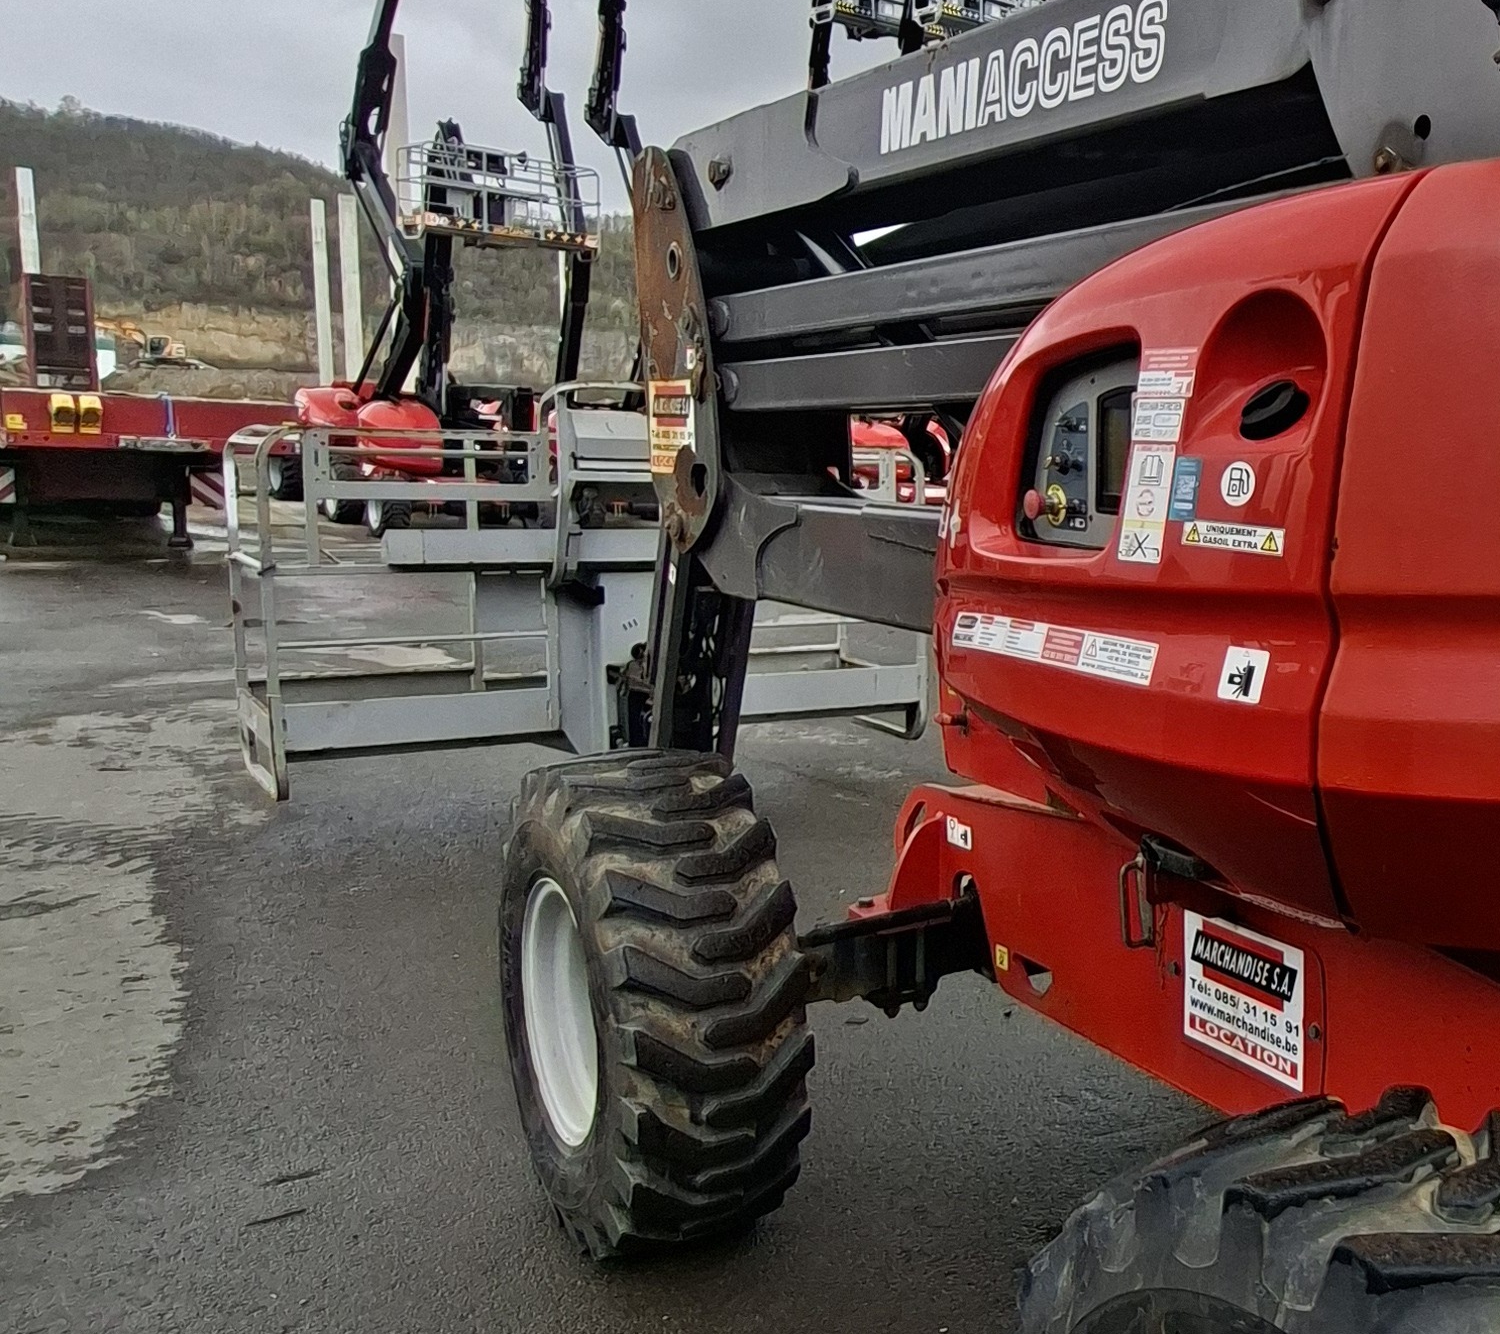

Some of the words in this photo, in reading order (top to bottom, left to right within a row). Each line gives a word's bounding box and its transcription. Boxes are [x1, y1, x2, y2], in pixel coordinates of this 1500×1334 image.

[1202, 536, 1229, 546] GASOIL
[1232, 539, 1258, 550] EXTRA
[1206, 525, 1257, 537] UNIQUEMENT
[1194, 935, 1270, 986] MARCHANDISE
[1271, 968, 1291, 997] S.A.
[1189, 977, 1211, 997] Tél:
[1243, 1001, 1257, 1017] 31
[1262, 1010, 1277, 1026] 15
[1285, 1020, 1300, 1037] 91
[1190, 995, 1298, 1056] www.marchandise.be
[1194, 1014, 1292, 1075] LOCATION
